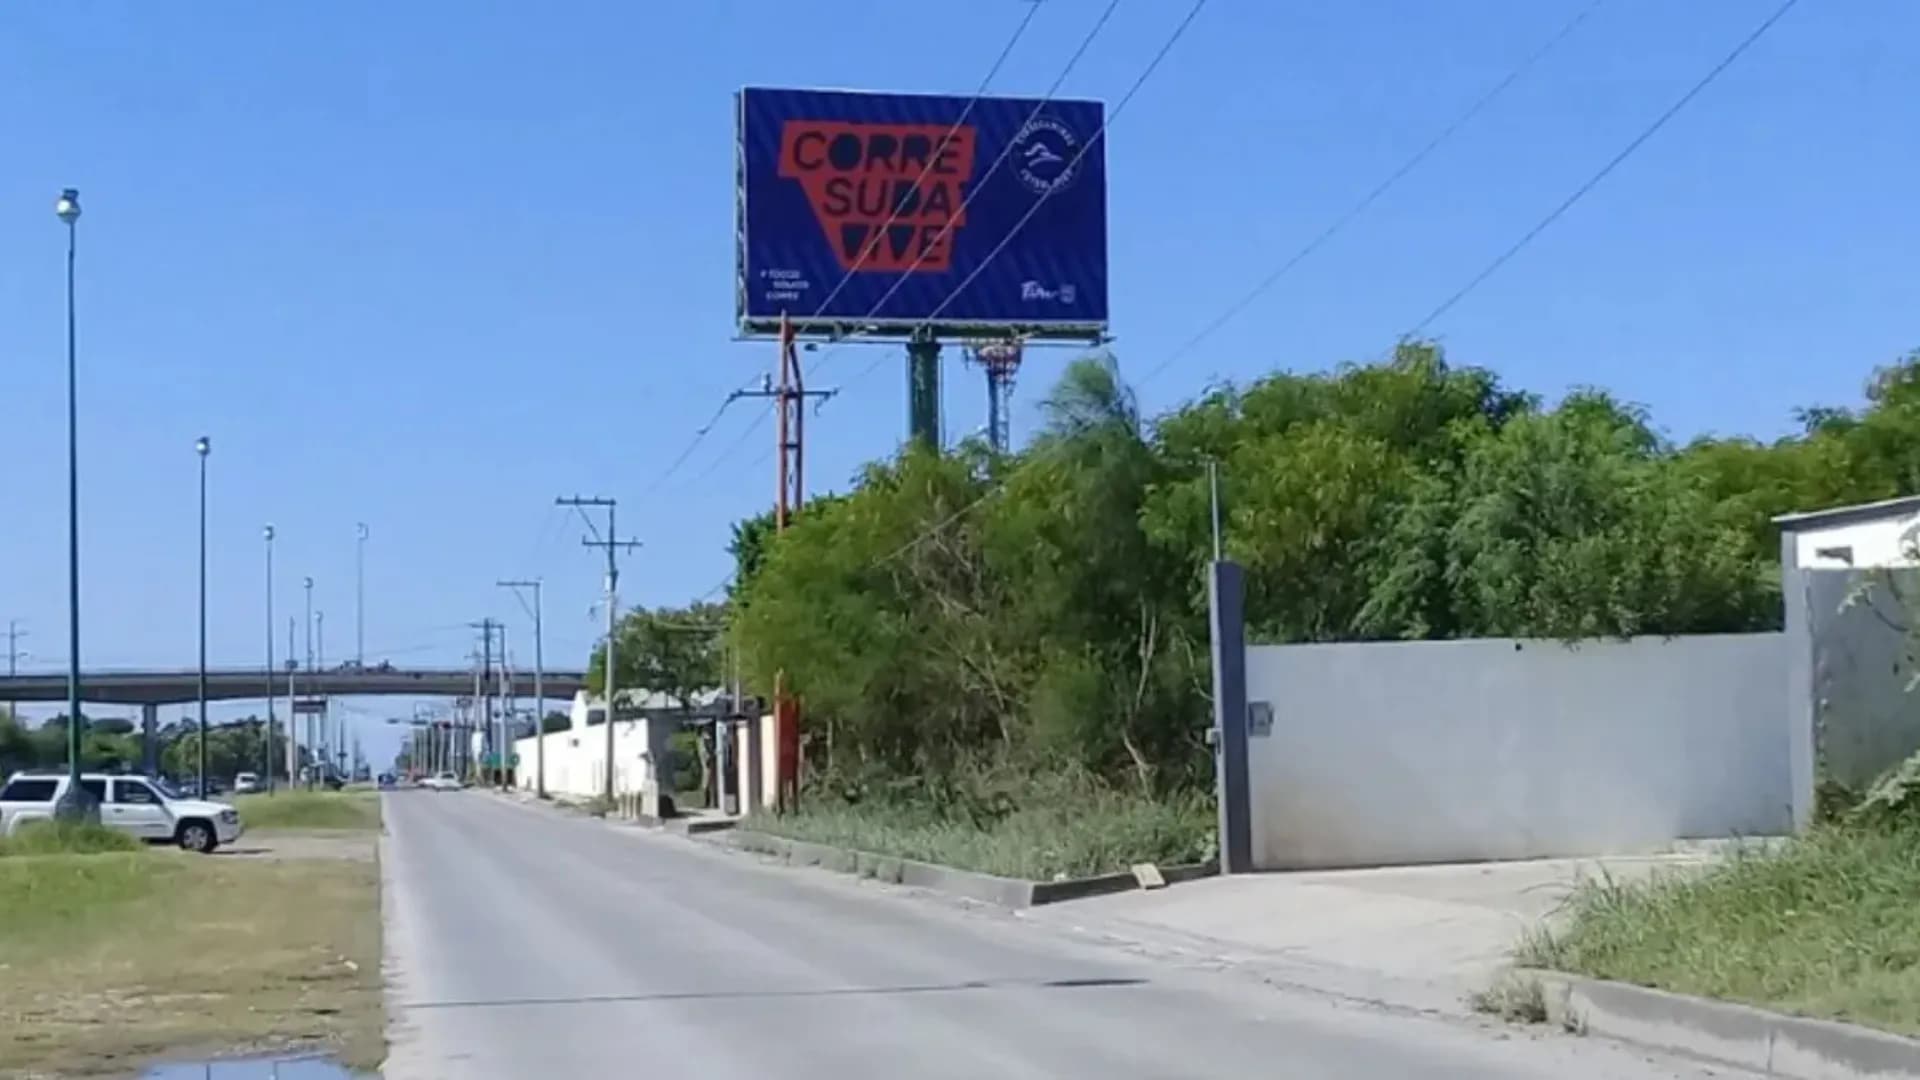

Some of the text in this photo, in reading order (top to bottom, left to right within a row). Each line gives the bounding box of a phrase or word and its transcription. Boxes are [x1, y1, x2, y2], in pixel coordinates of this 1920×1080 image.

[792, 130, 962, 174] CORRE
[822, 177, 951, 219] SUDA
[840, 222, 944, 263] VIVE
